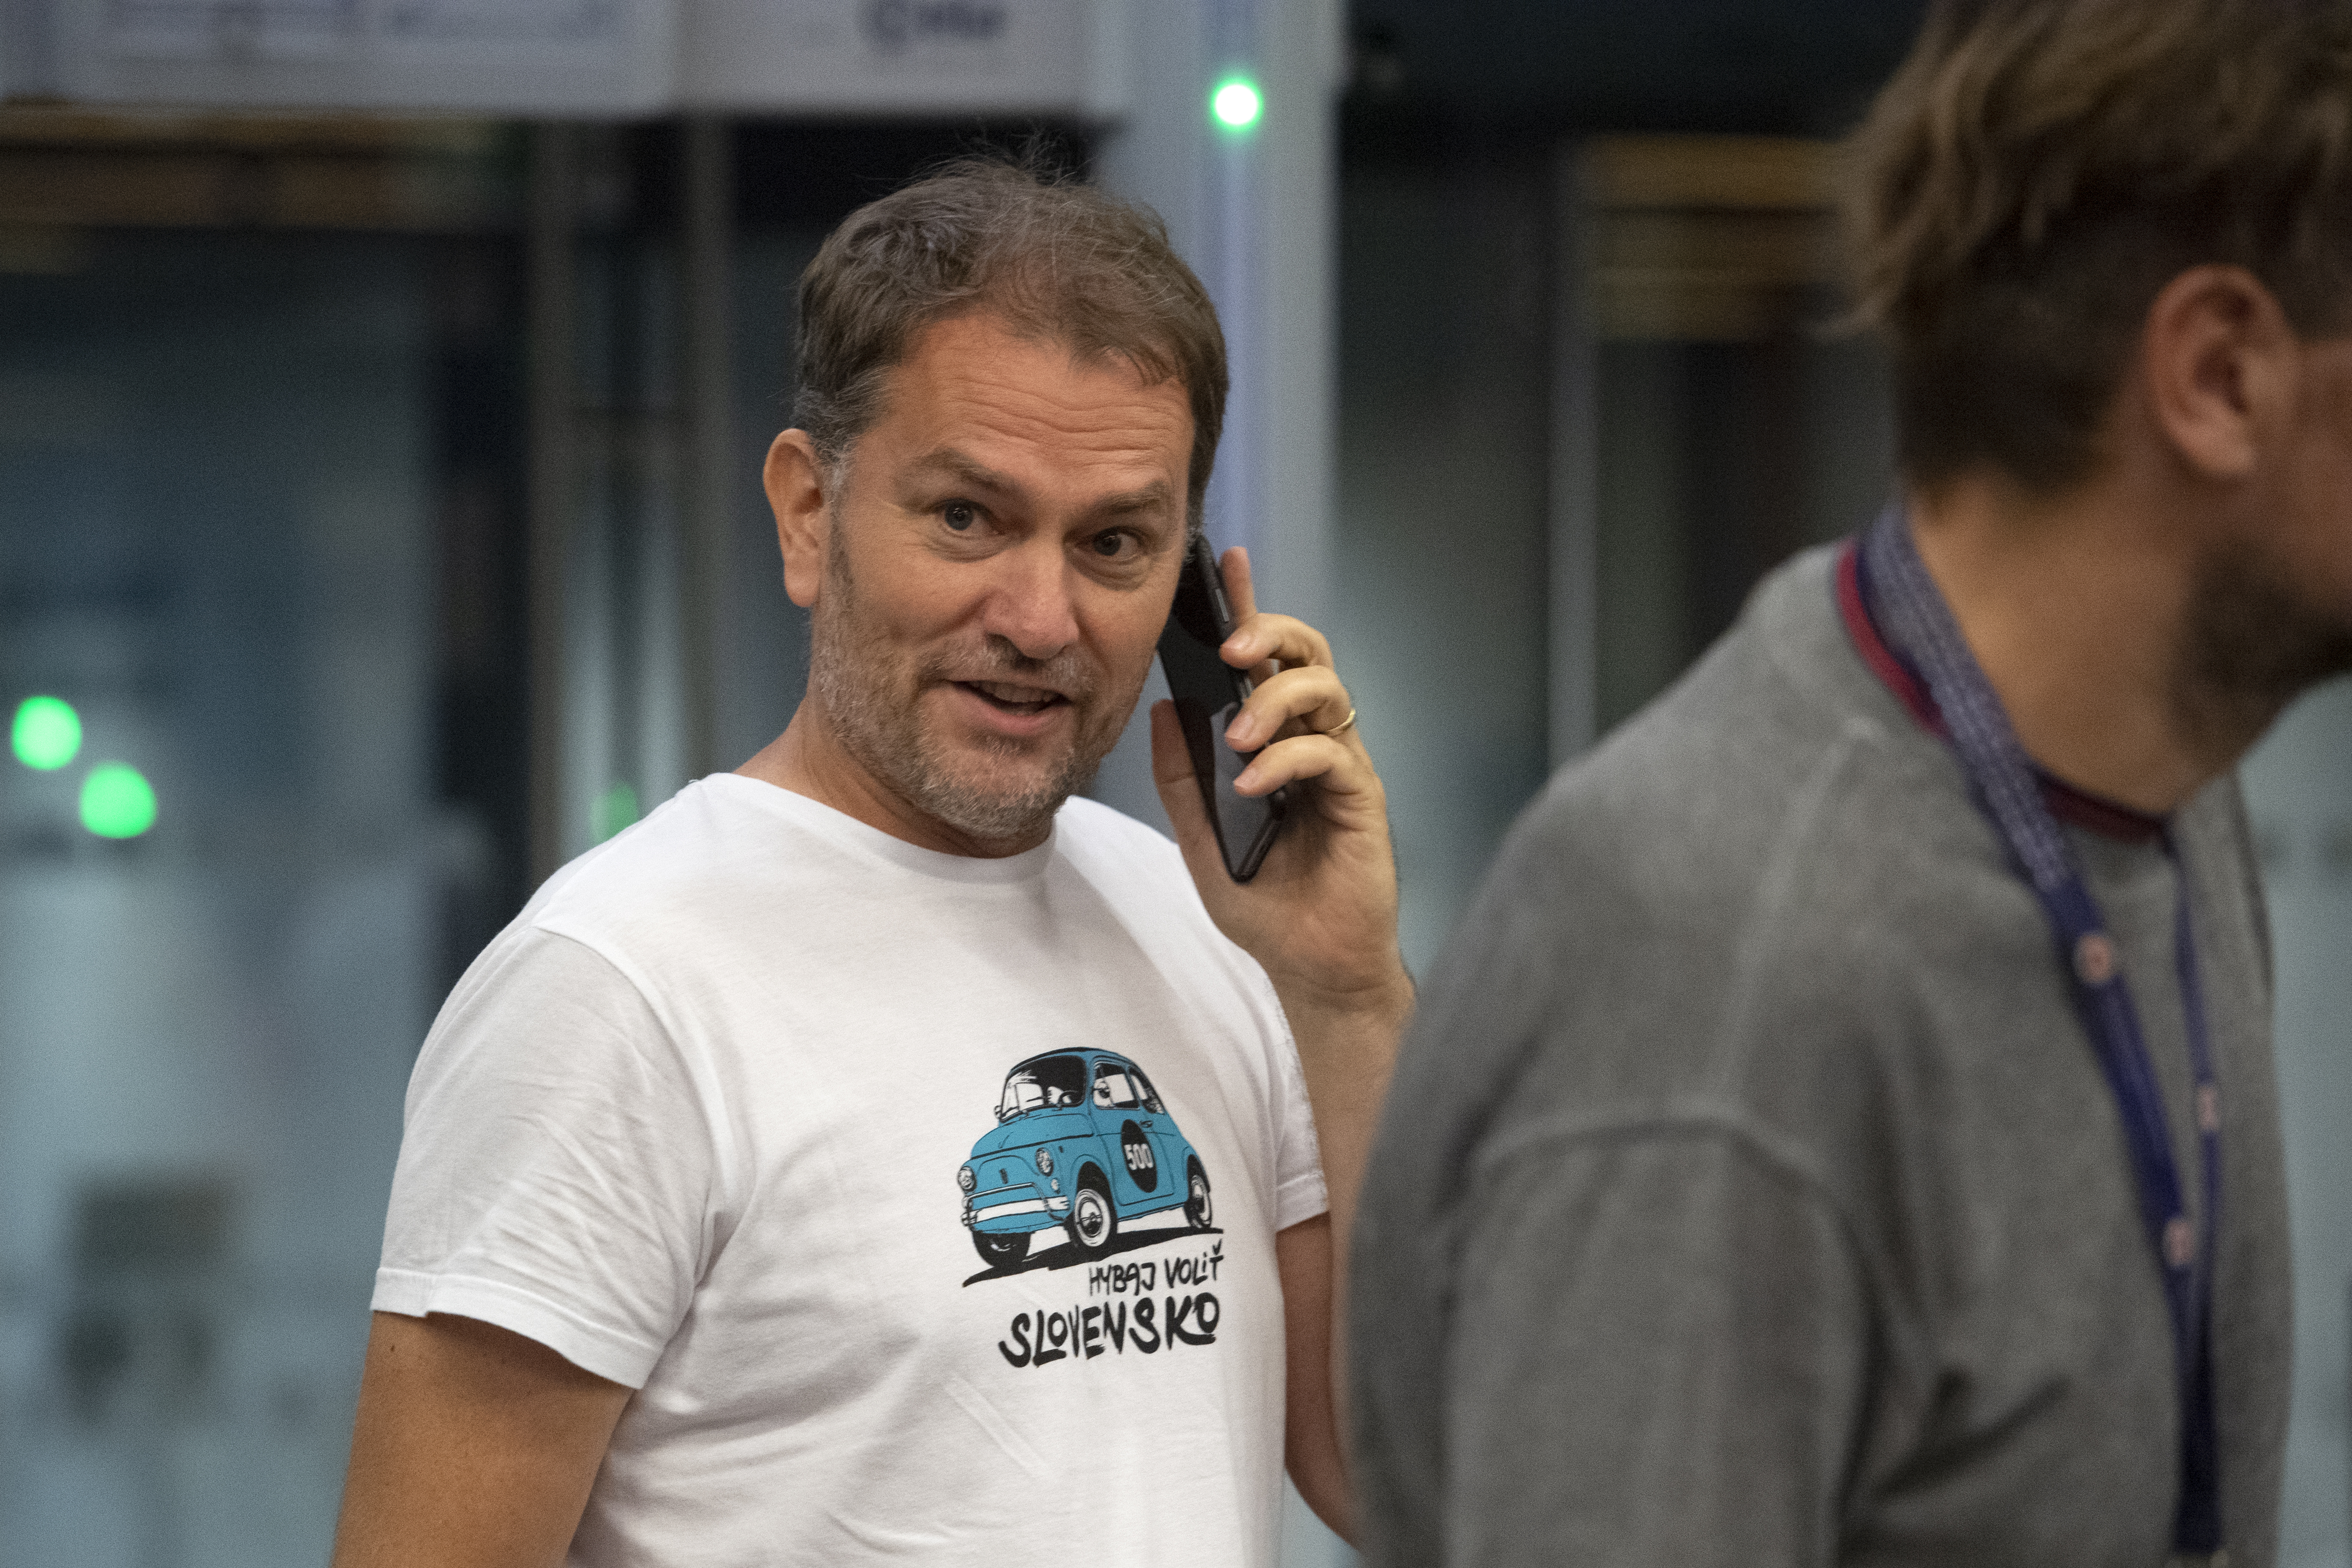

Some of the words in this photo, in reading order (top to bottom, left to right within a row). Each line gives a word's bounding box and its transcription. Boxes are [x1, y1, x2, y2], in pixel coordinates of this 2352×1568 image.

[1124, 1143, 1152, 1170] 500
[1089, 1262, 1156, 1296] HYBAJ
[998, 1292, 1220, 1368] SLOVENSKO
